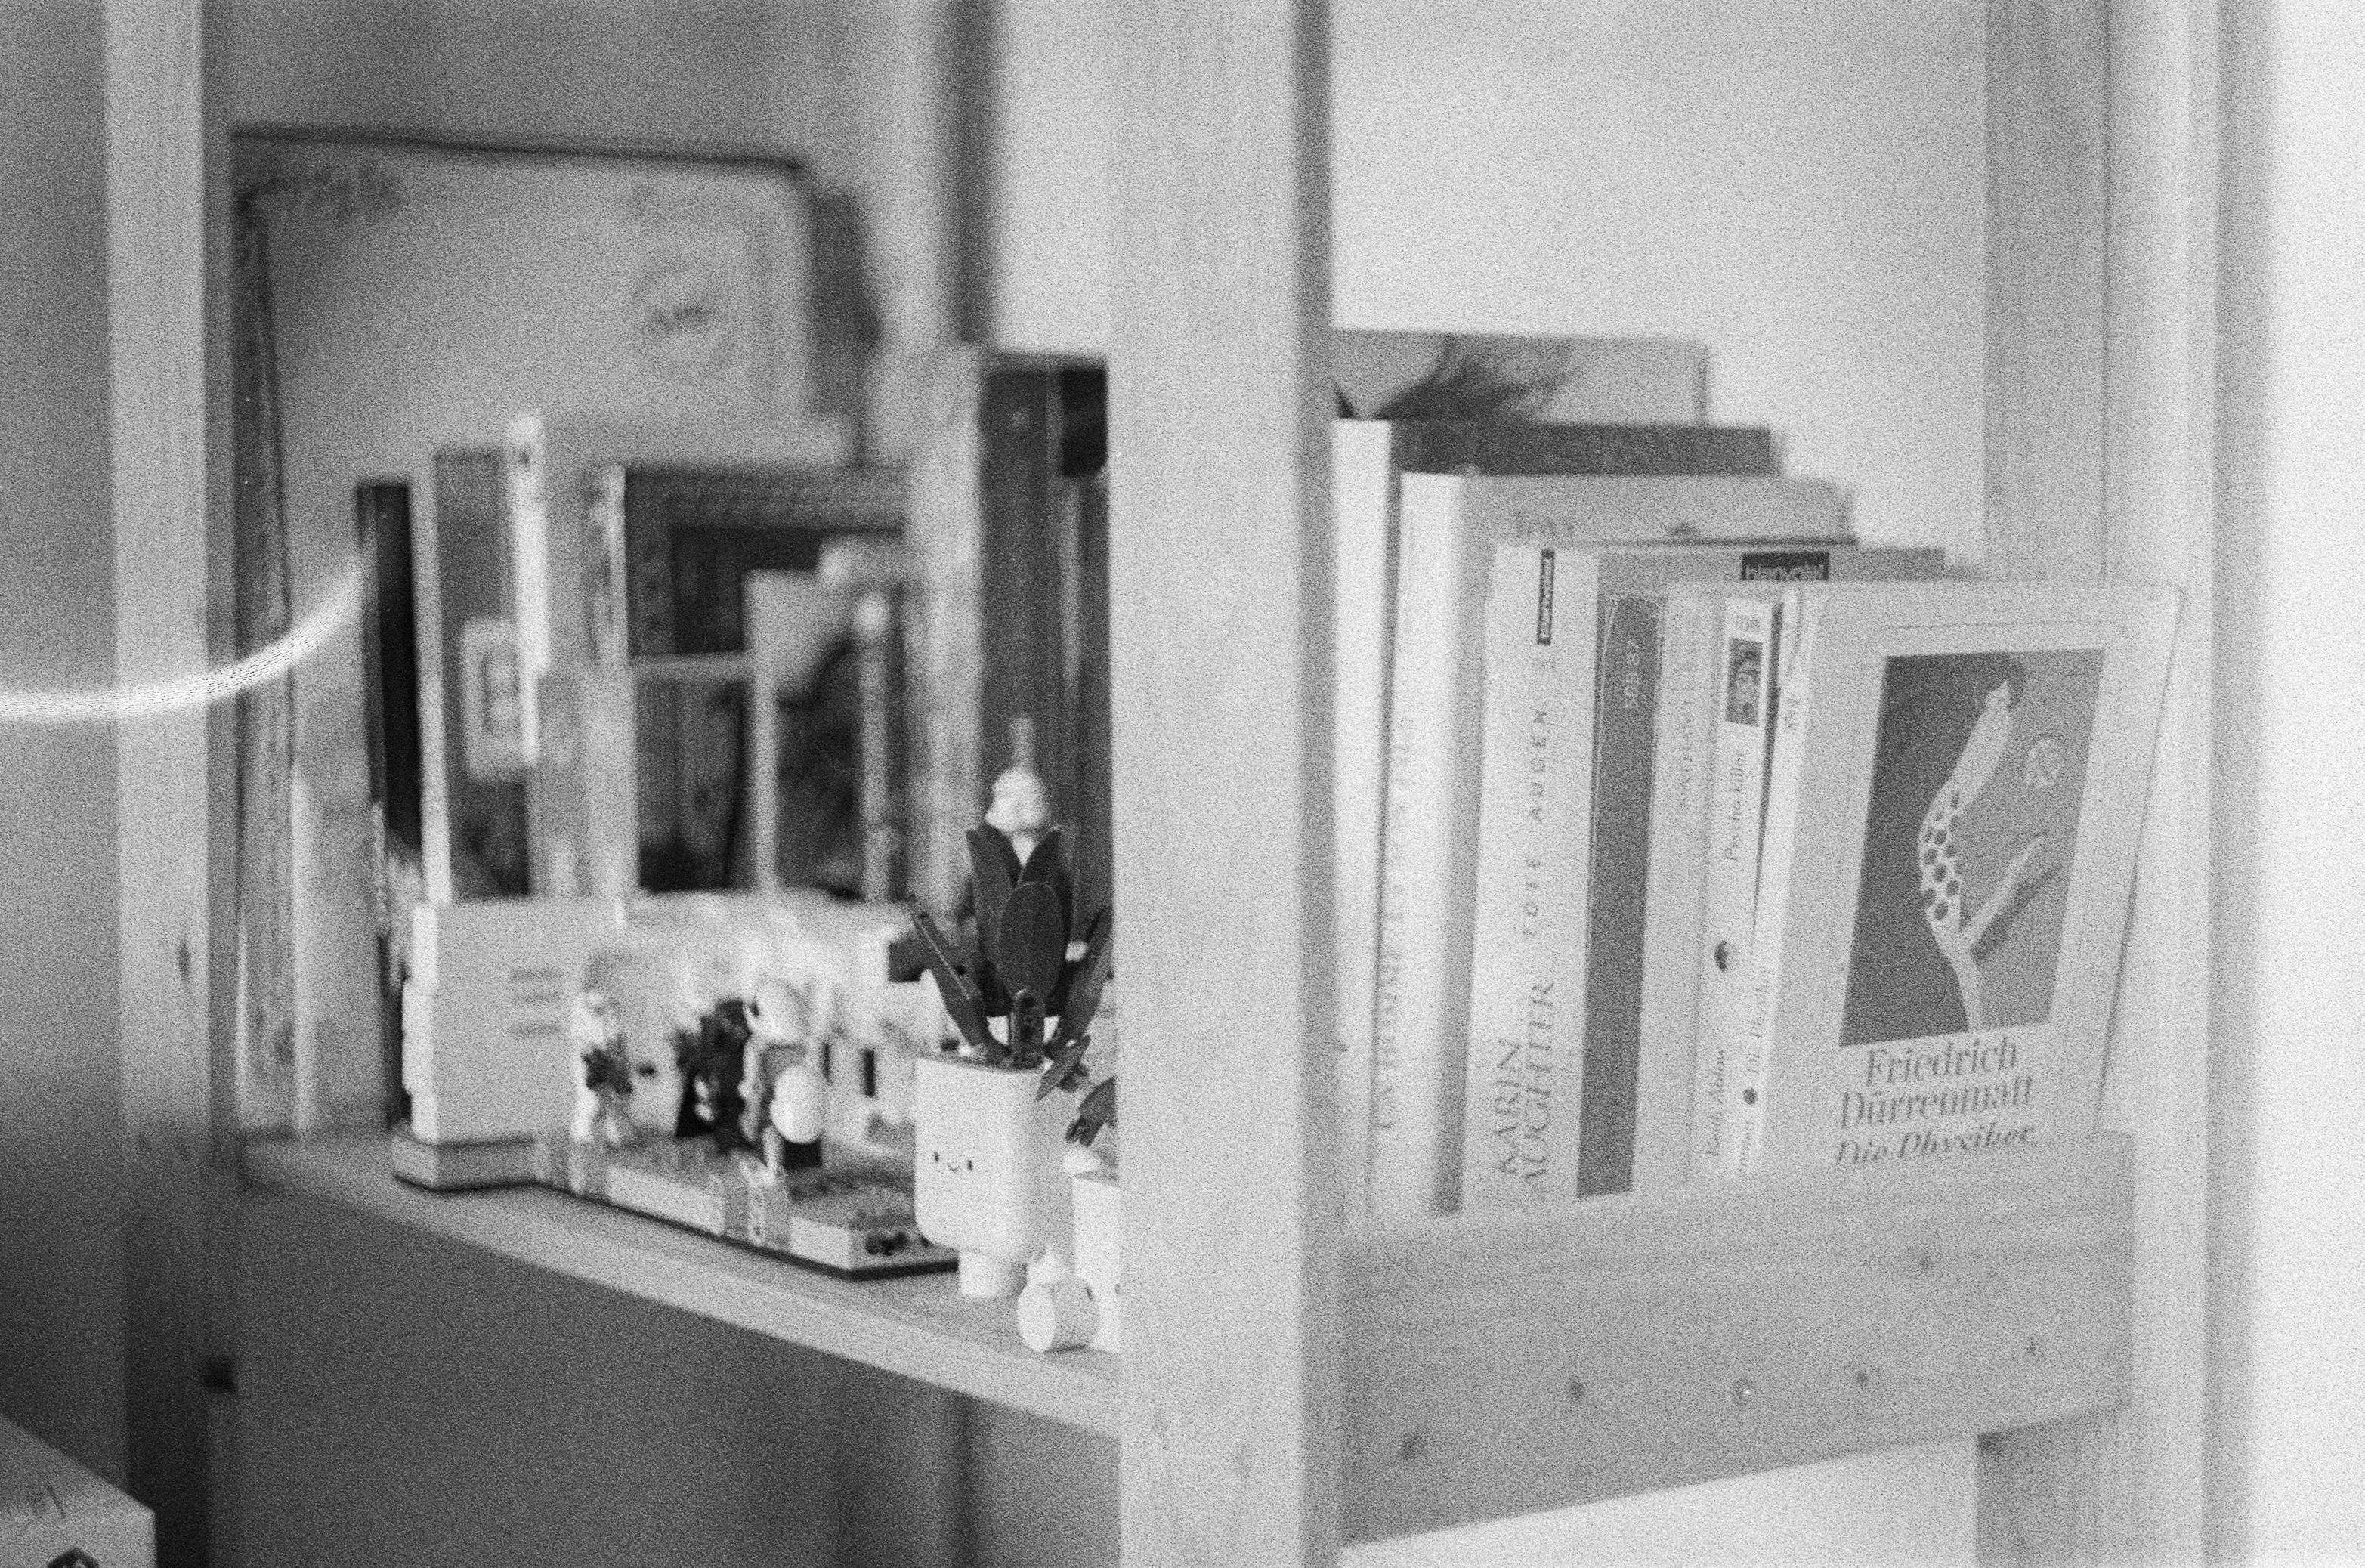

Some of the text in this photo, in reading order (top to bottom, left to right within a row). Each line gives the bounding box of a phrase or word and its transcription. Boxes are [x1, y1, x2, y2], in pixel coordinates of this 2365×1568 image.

[1522, 709, 1547, 939] TOTE AUGEN
[1724, 751, 1744, 861] Psycho killer
[1865, 1035, 2019, 1087] Friedrich
[1493, 1038, 1522, 1176] KARIN
[1840, 1075, 2034, 1130] Dürrenmatt
[1835, 1140, 1889, 1167] Die
